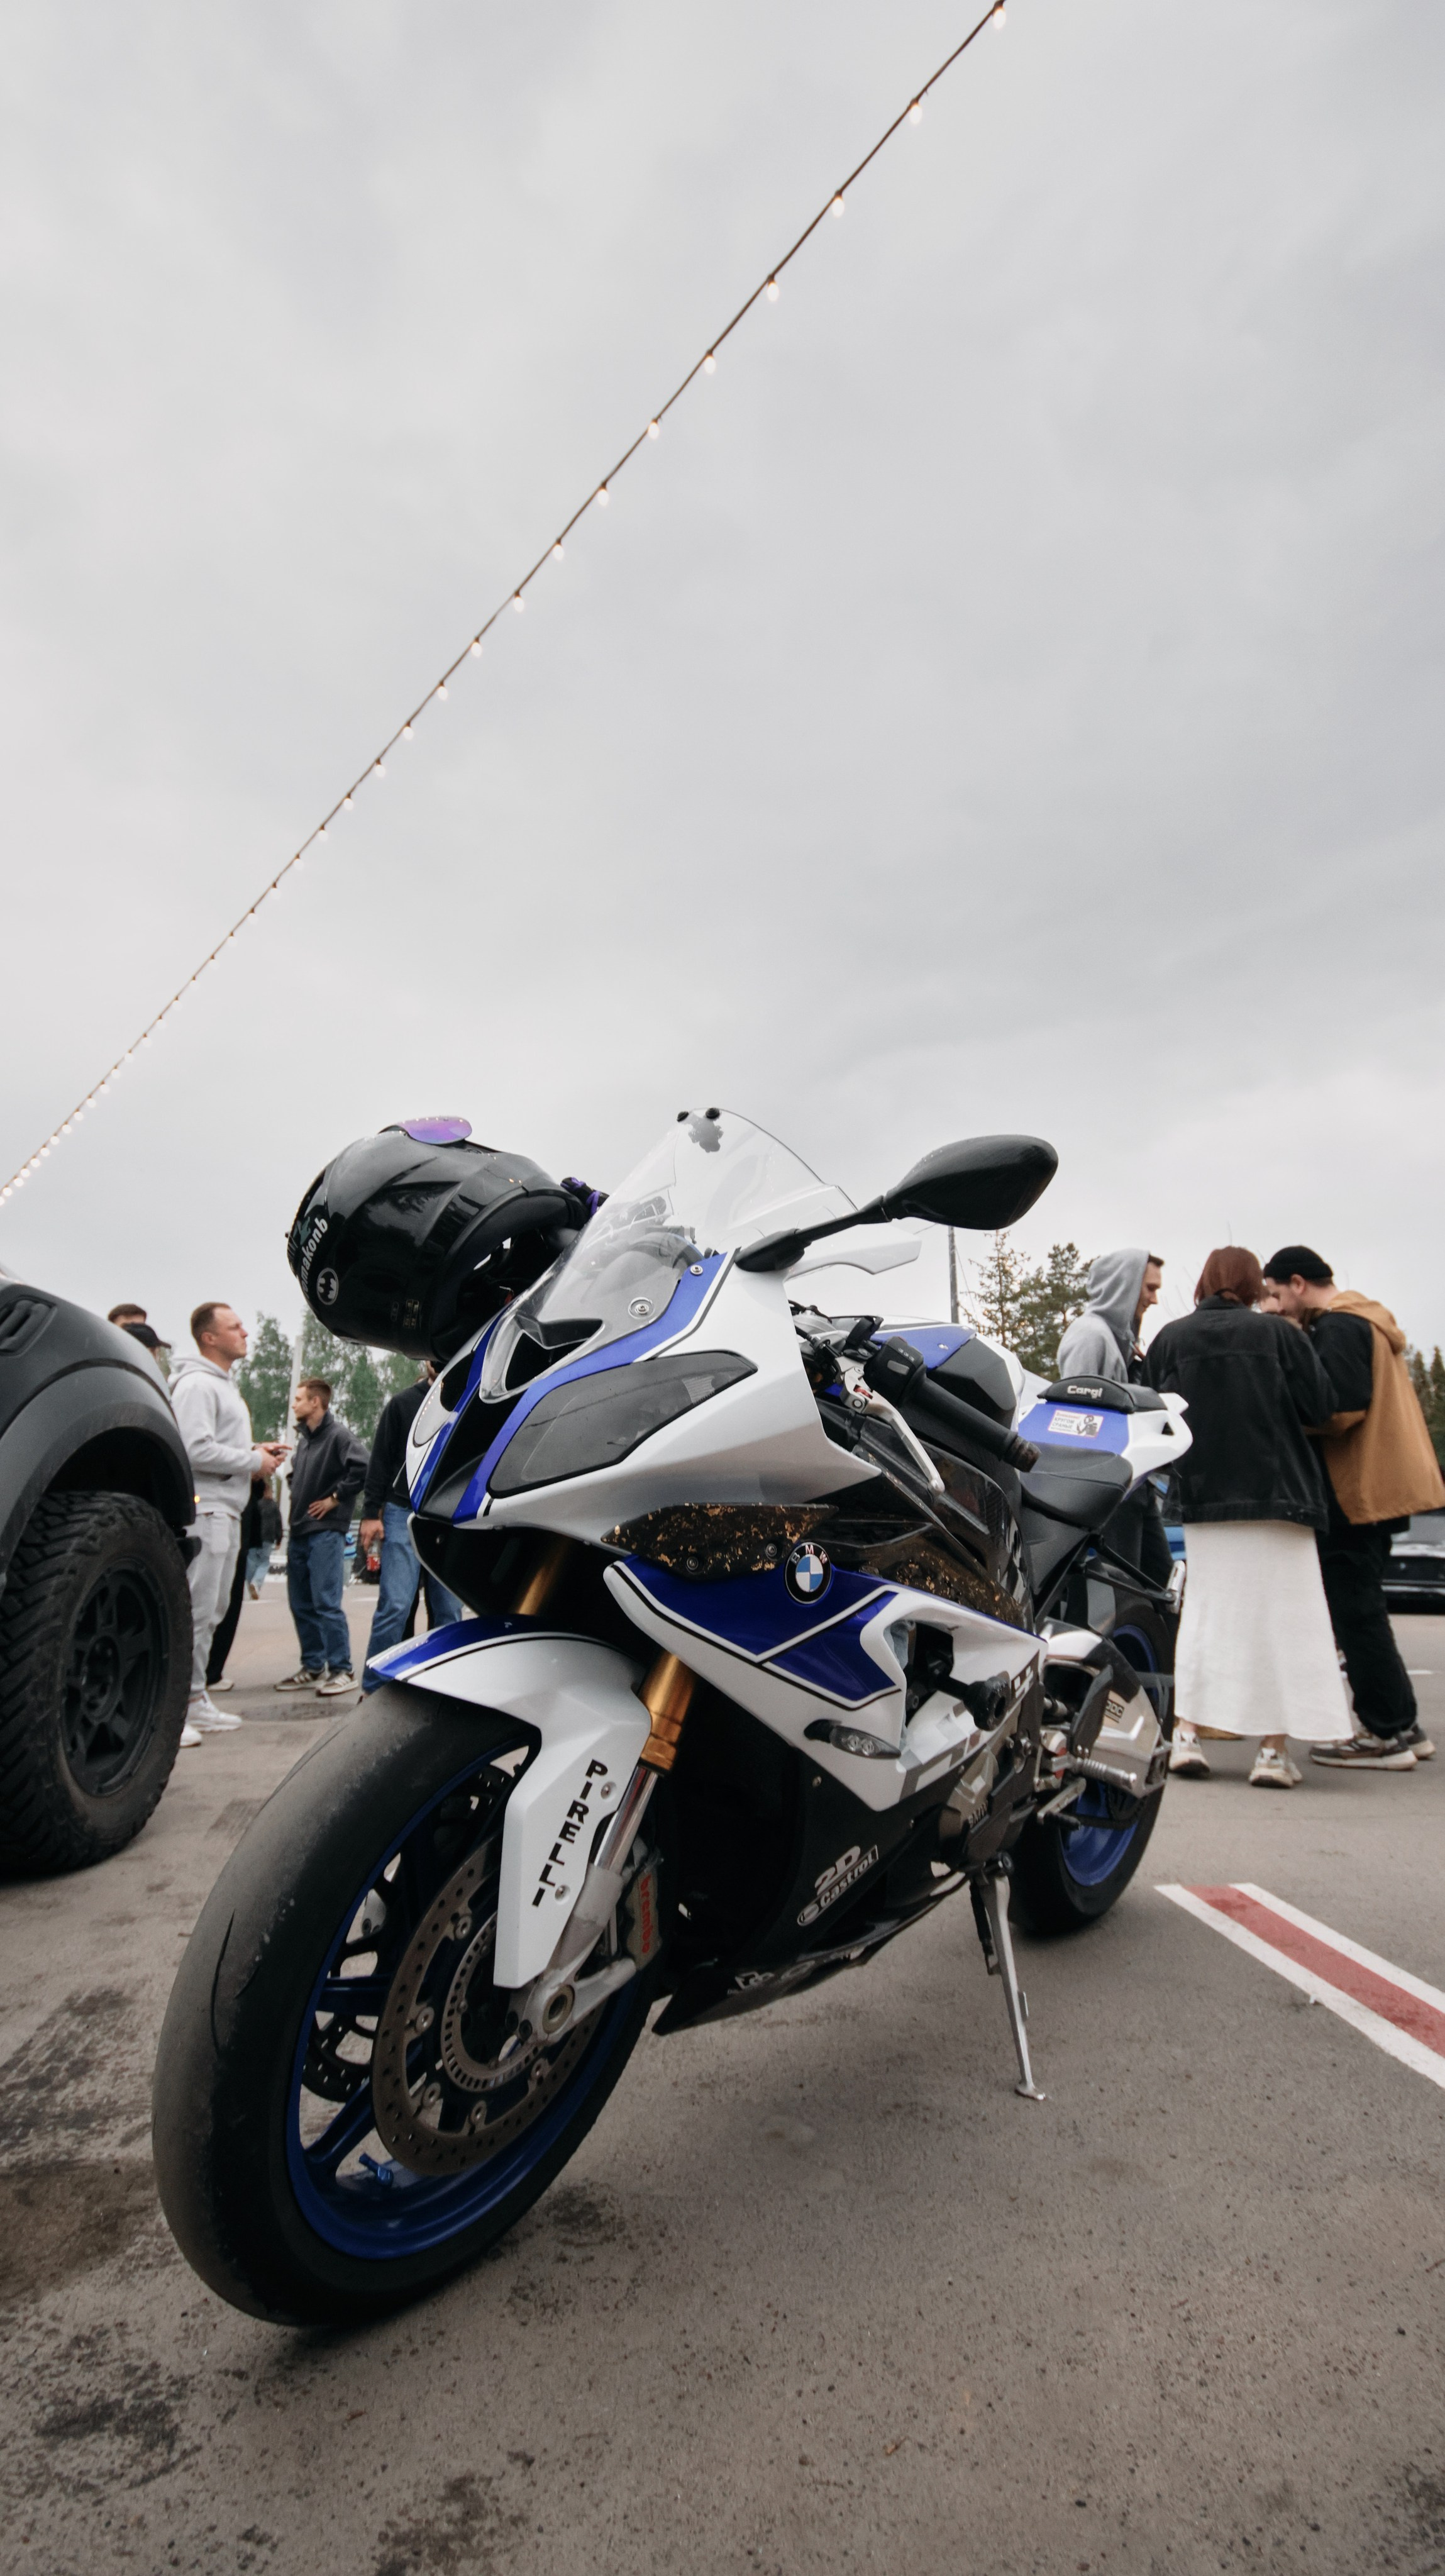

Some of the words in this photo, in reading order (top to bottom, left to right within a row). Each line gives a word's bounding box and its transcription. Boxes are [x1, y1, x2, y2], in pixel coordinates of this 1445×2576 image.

[790, 1544, 828, 1564] BMW
[532, 1759, 608, 1907] PIRELLI
[640, 1874, 652, 1953] brembo
[820, 1852, 873, 1908] Castrol
